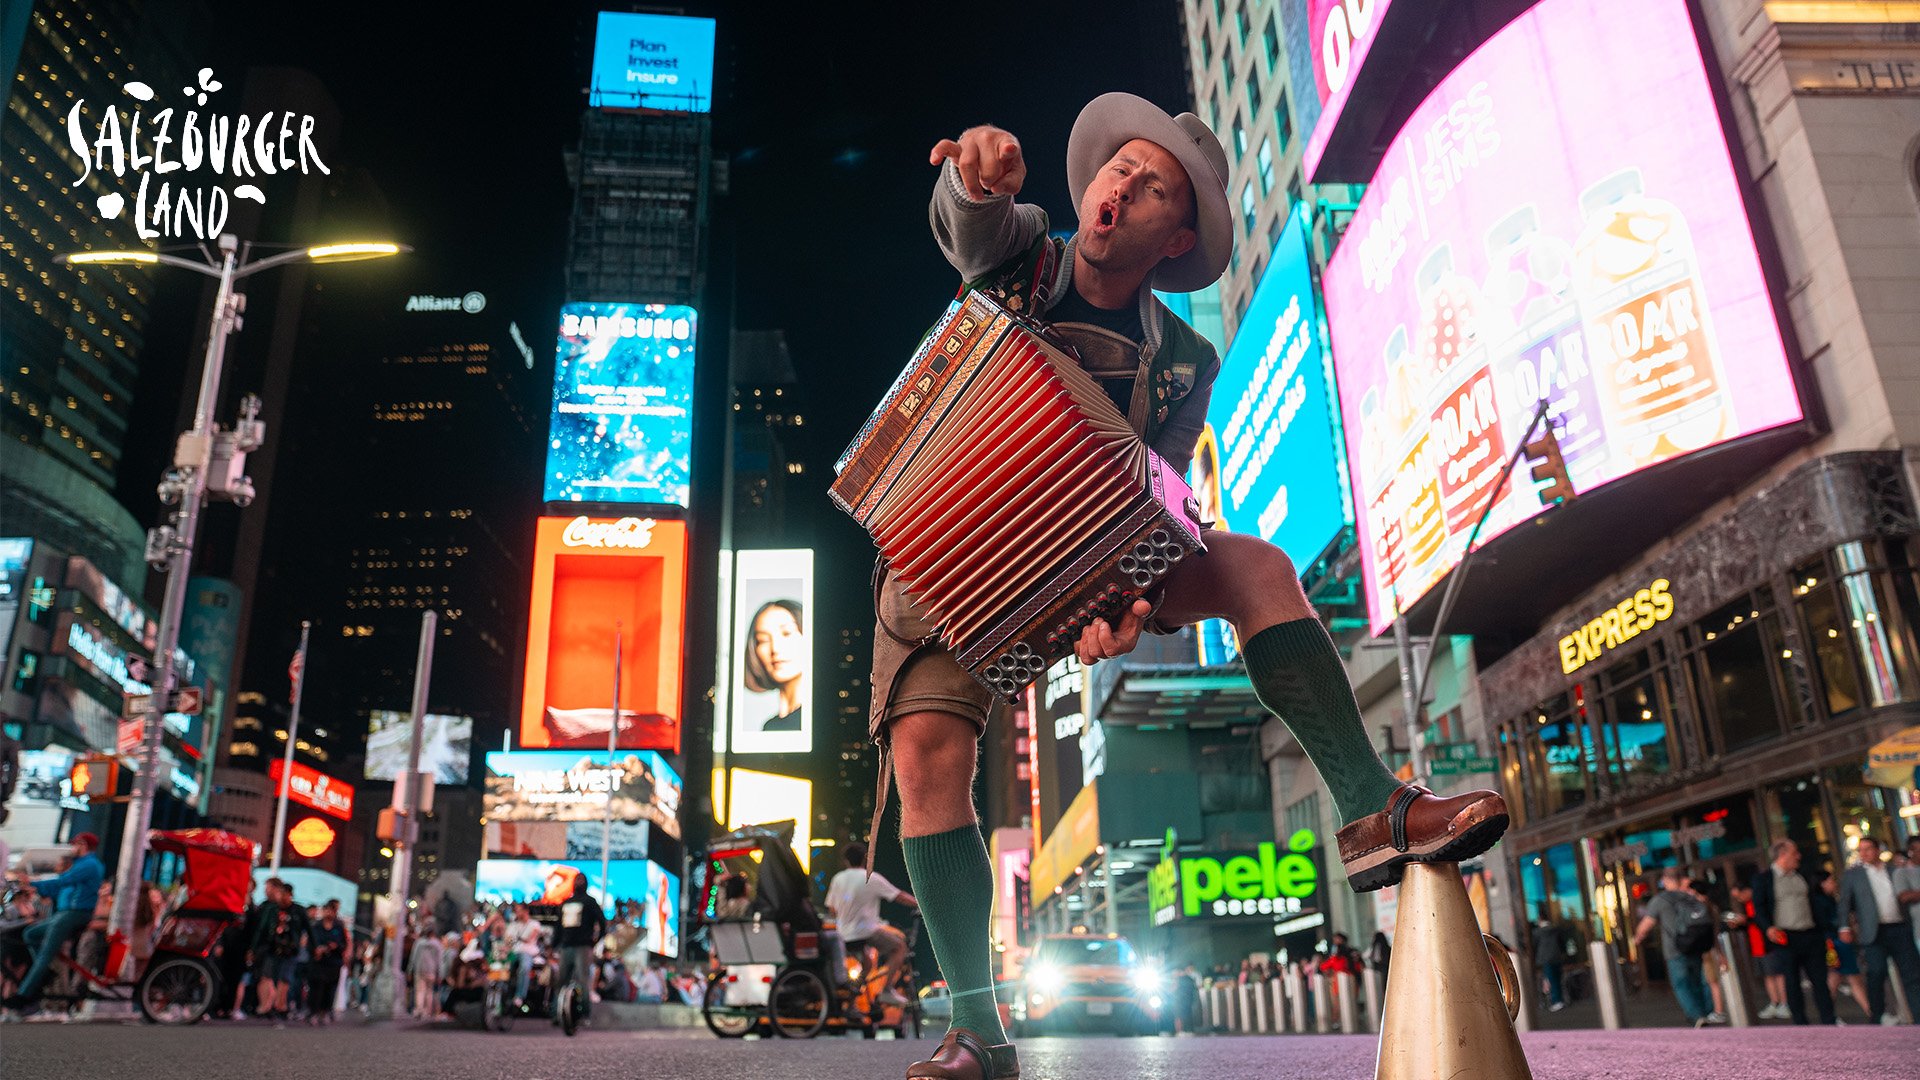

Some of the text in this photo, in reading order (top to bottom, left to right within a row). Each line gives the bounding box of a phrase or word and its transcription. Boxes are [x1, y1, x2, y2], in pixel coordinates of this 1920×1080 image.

[629, 38, 667, 53] Plan
[628, 54, 679, 70] Invest
[626, 69, 678, 85] Insure
[1420, 81, 1494, 175] JESS
[1426, 116, 1502, 206] SIMS
[405, 294, 462, 312] Allianz
[563, 313, 690, 341] SAMSUNG
[1558, 578, 1674, 674] EXPRESS
[566, 768, 625, 793] WEST
[1180, 828, 1318, 916] pelé
[1212, 896, 1302, 917] SOCCER
